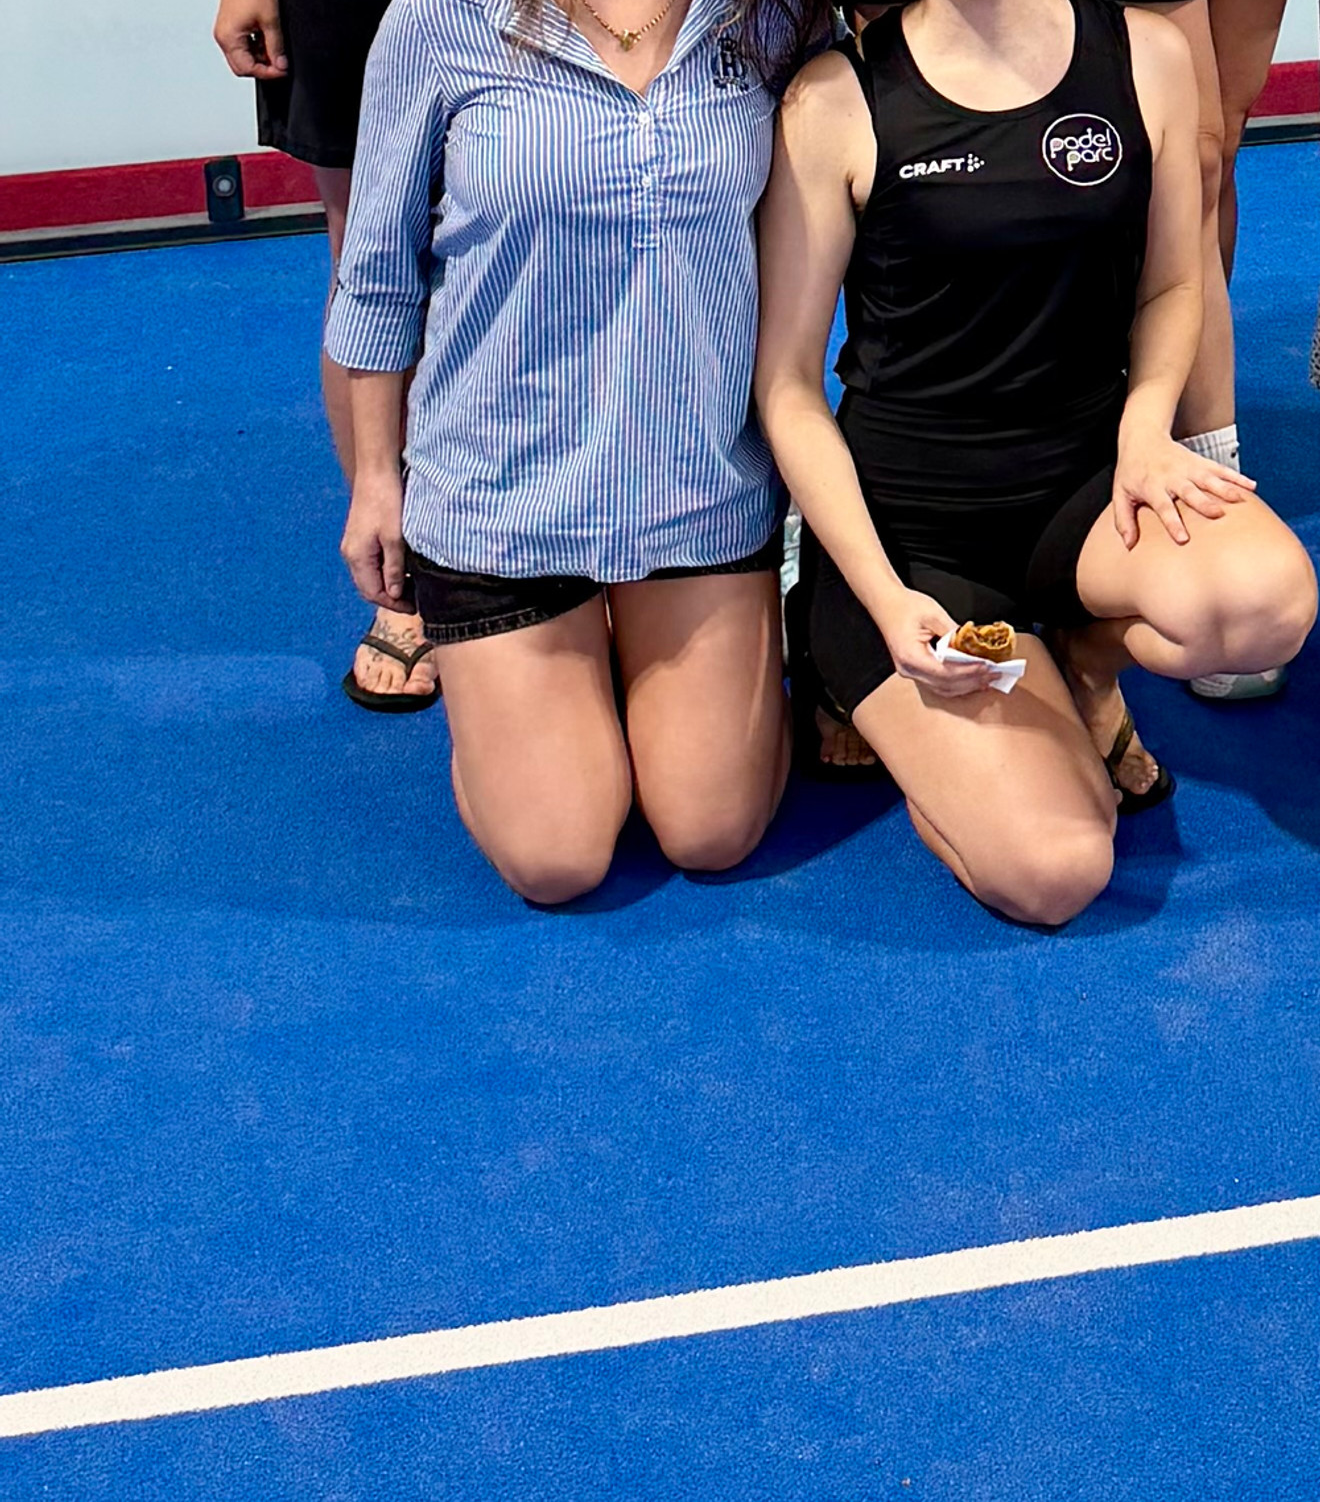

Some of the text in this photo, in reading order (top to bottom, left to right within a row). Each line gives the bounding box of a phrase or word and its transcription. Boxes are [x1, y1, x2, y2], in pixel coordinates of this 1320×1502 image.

[1049, 127, 1112, 159] padel
[899, 157, 966, 179] CRAFT
[1066, 147, 1114, 172] parc
